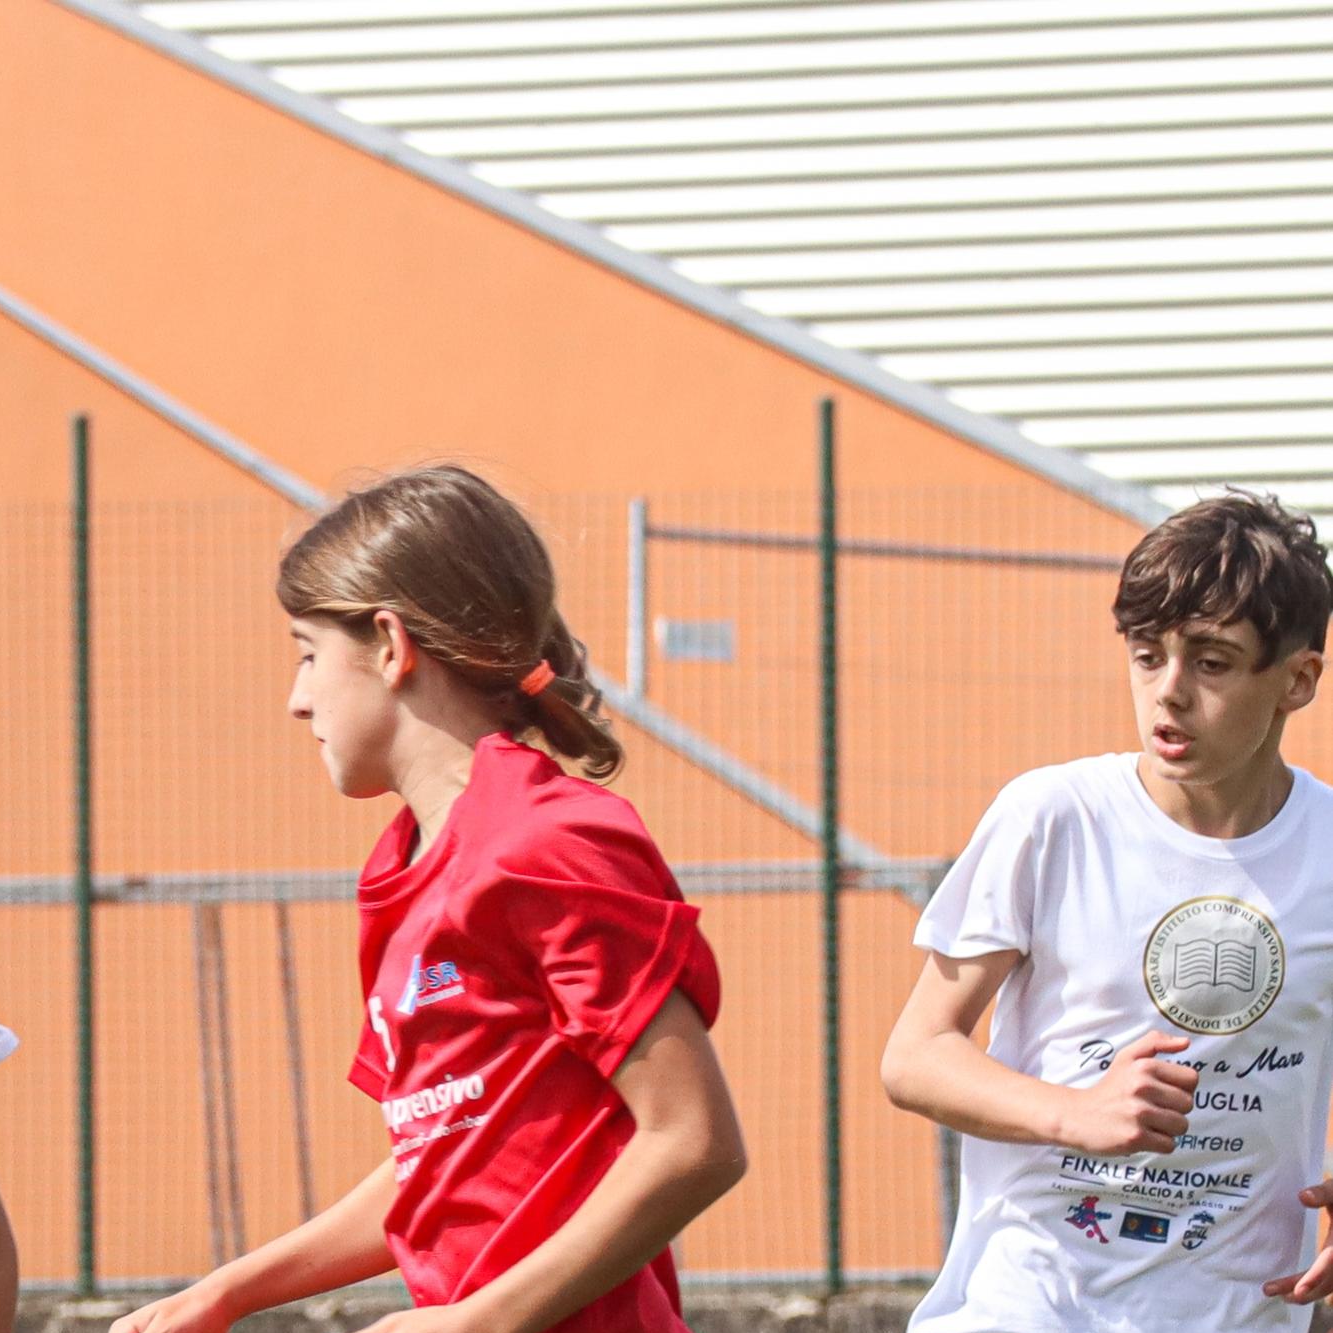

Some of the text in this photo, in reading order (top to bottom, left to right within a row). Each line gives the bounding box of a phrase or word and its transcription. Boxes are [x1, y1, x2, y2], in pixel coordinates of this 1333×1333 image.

[1155, 905, 1202, 950] ISTITUTO
[1195, 1091, 1263, 1112] UGLIA
[1061, 1155, 1253, 1189] FINALE NAZIONALE
[1122, 1184, 1172, 1199] CALCIO
[1174, 1189, 1184, 1200] A
